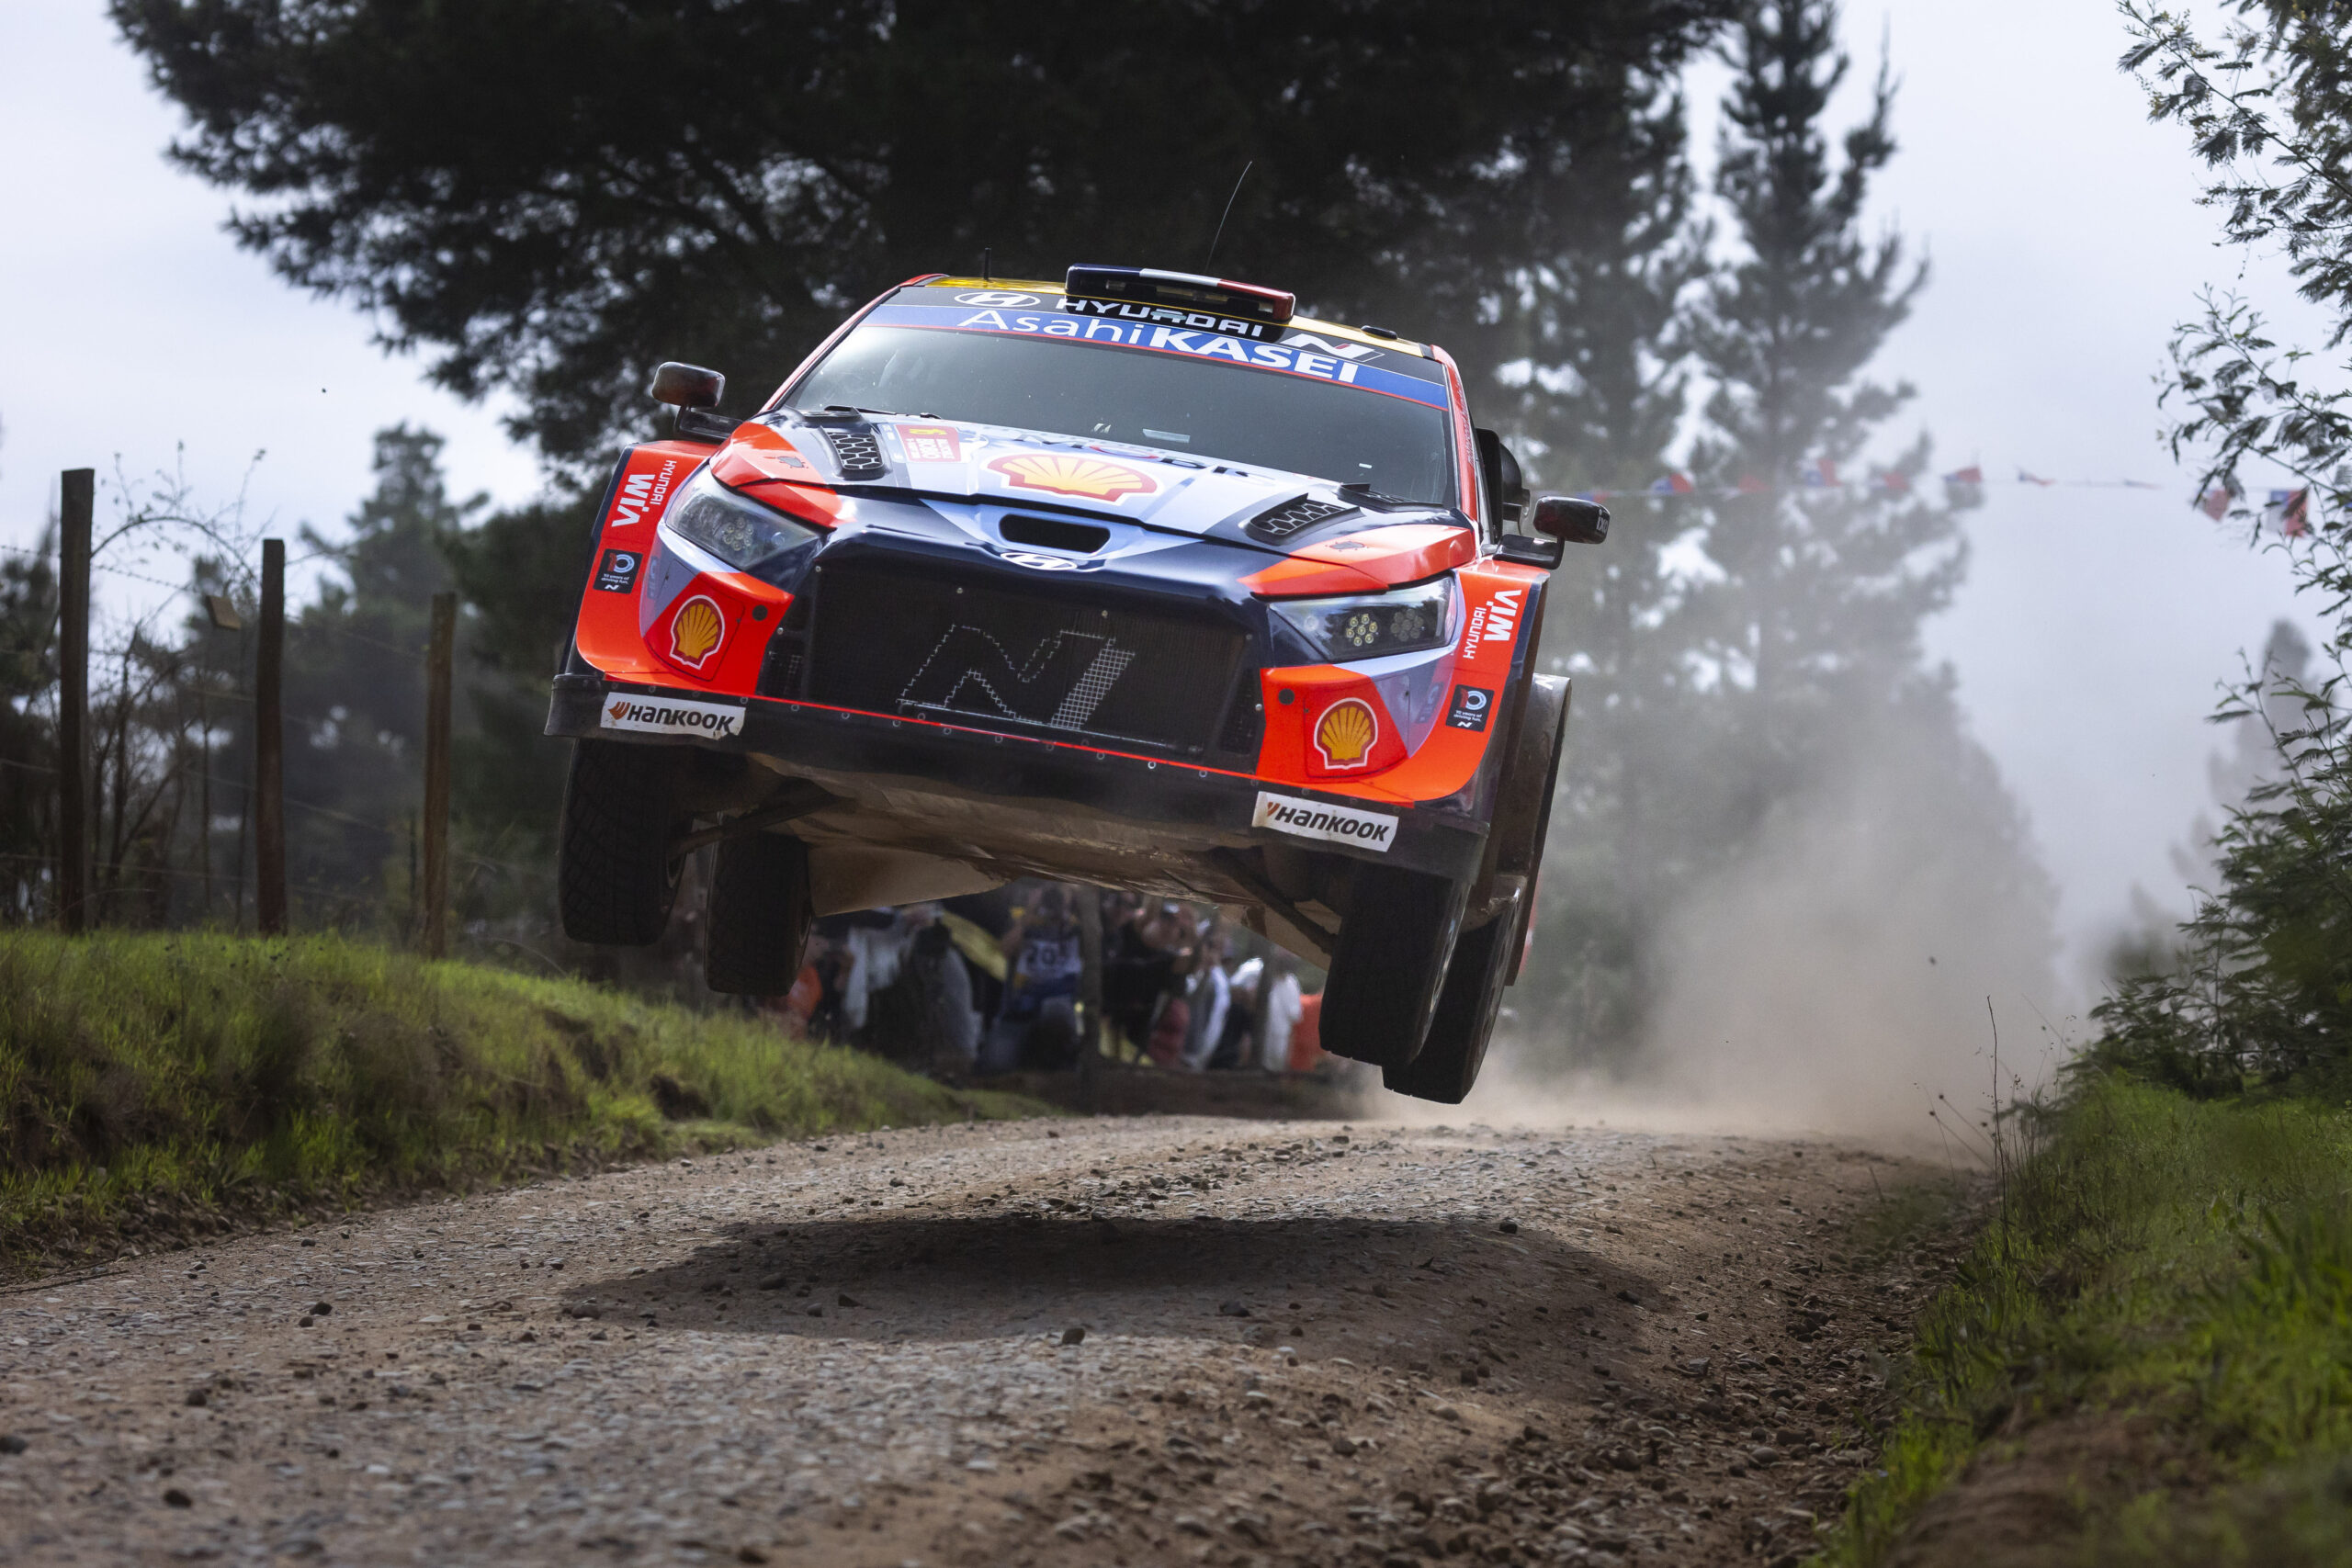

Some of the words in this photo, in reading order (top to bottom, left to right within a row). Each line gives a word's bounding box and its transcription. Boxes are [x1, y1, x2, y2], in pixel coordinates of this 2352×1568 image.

[1056, 299, 1262, 337] HYUNDAI
[650, 460, 677, 505] HYUNDAI
[1463, 606, 1487, 660] HYUNDAI
